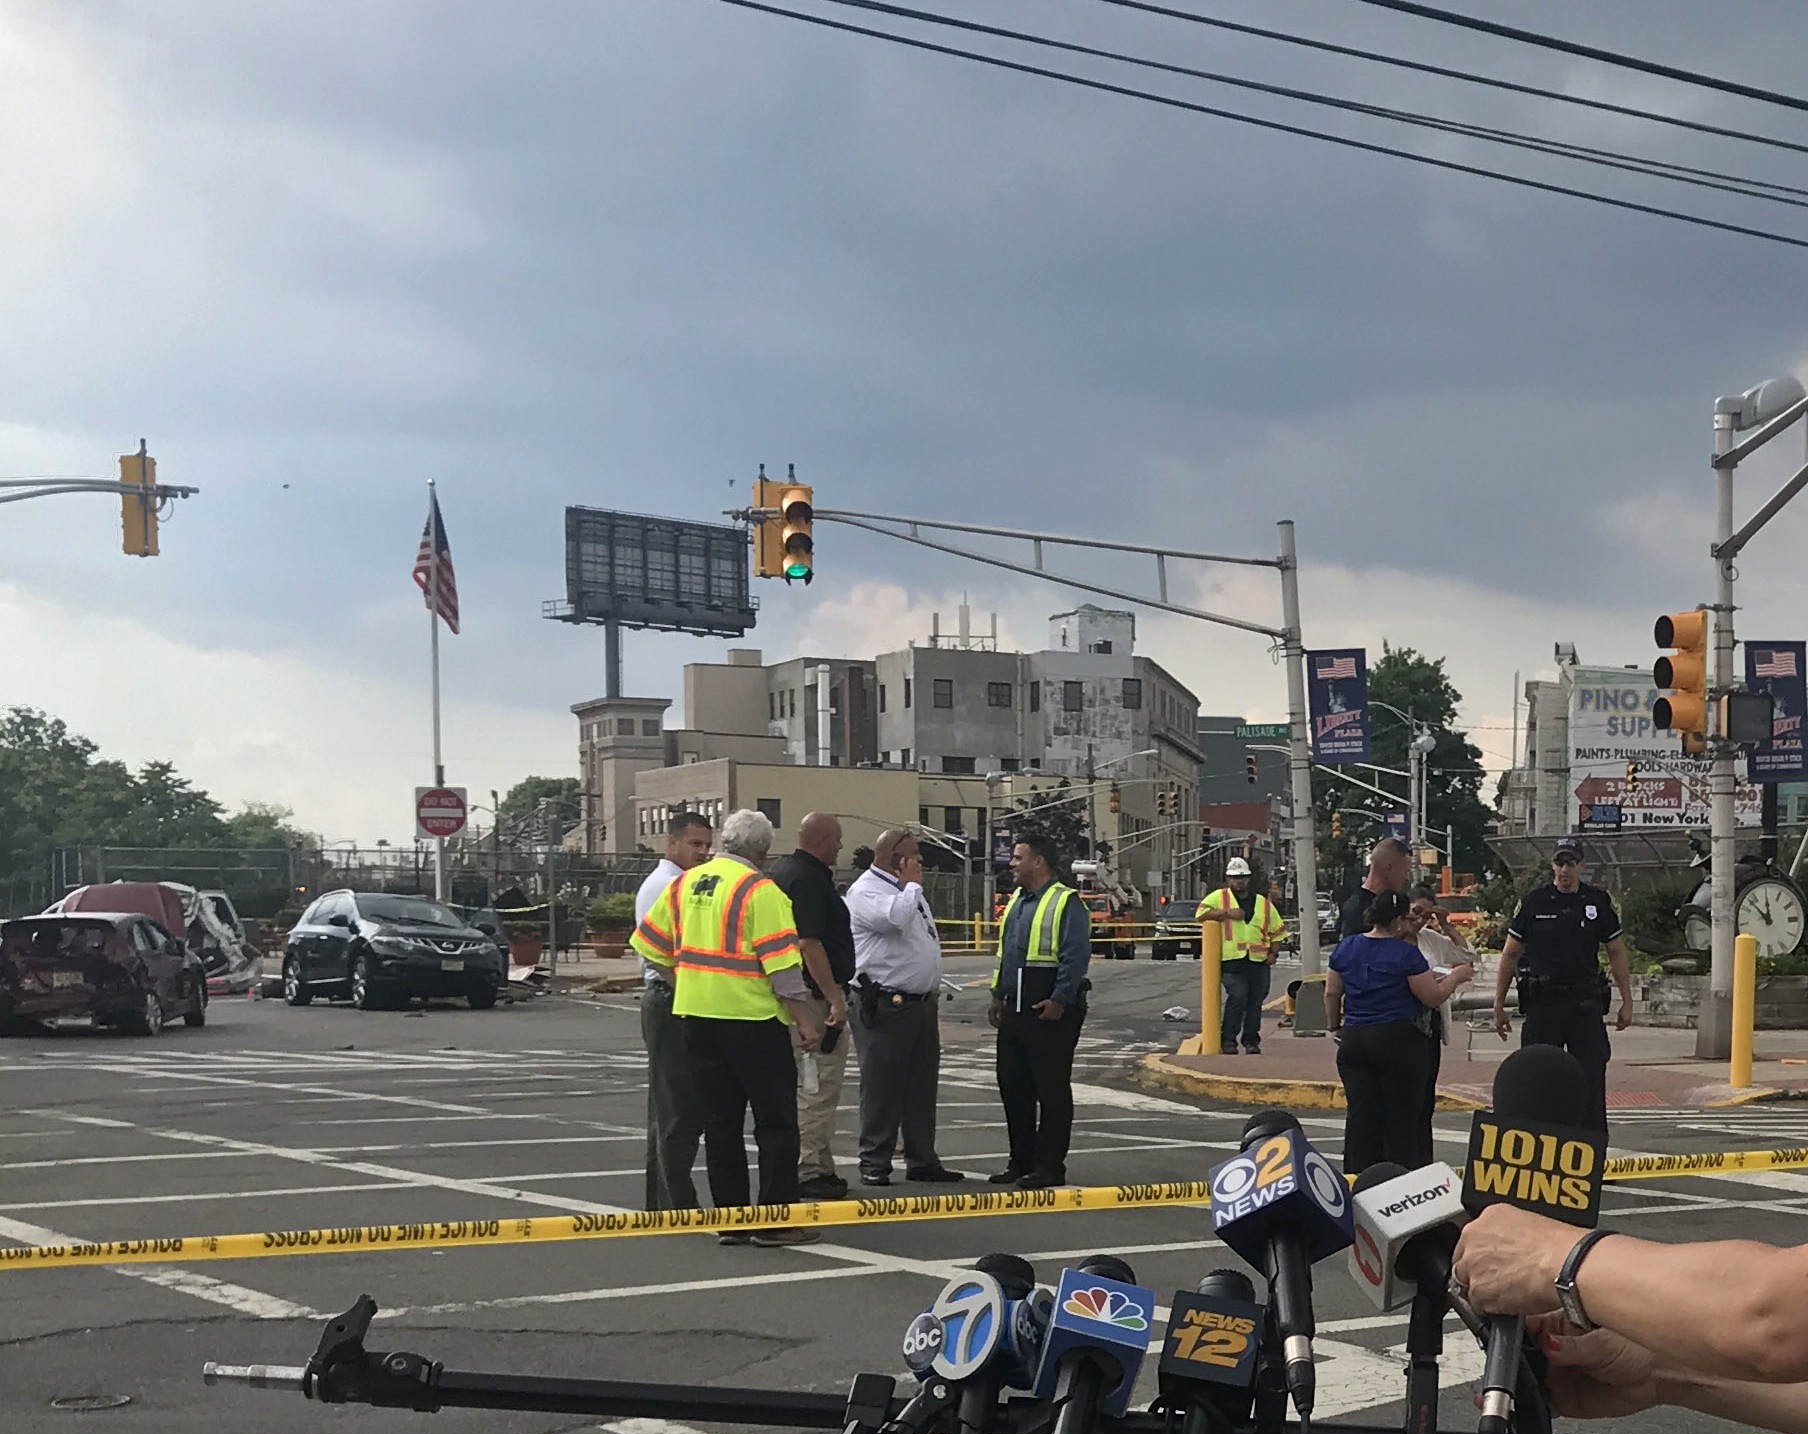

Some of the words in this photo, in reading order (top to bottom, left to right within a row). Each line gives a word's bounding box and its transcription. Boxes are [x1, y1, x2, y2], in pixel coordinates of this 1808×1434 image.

[1579, 689, 1636, 712] PINO
[1236, 726, 1276, 738] PALISADE
[1606, 781, 1616, 791] 2
[1618, 780, 1665, 791] BOCKS
[1643, 813, 1675, 824] New
[1675, 813, 1709, 824] York
[1255, 1136, 1292, 1189] 2
[1479, 1122, 1595, 1177] 1010
[1473, 1159, 1592, 1210] WINS
[1215, 1175, 1296, 1228] NEWS
[1377, 1183, 1449, 1218] verizon
[1017, 1314, 1039, 1344] abc
[1183, 1309, 1256, 1335] NEWS
[903, 1327, 941, 1356] abc
[1172, 1325, 1248, 1368] 12
